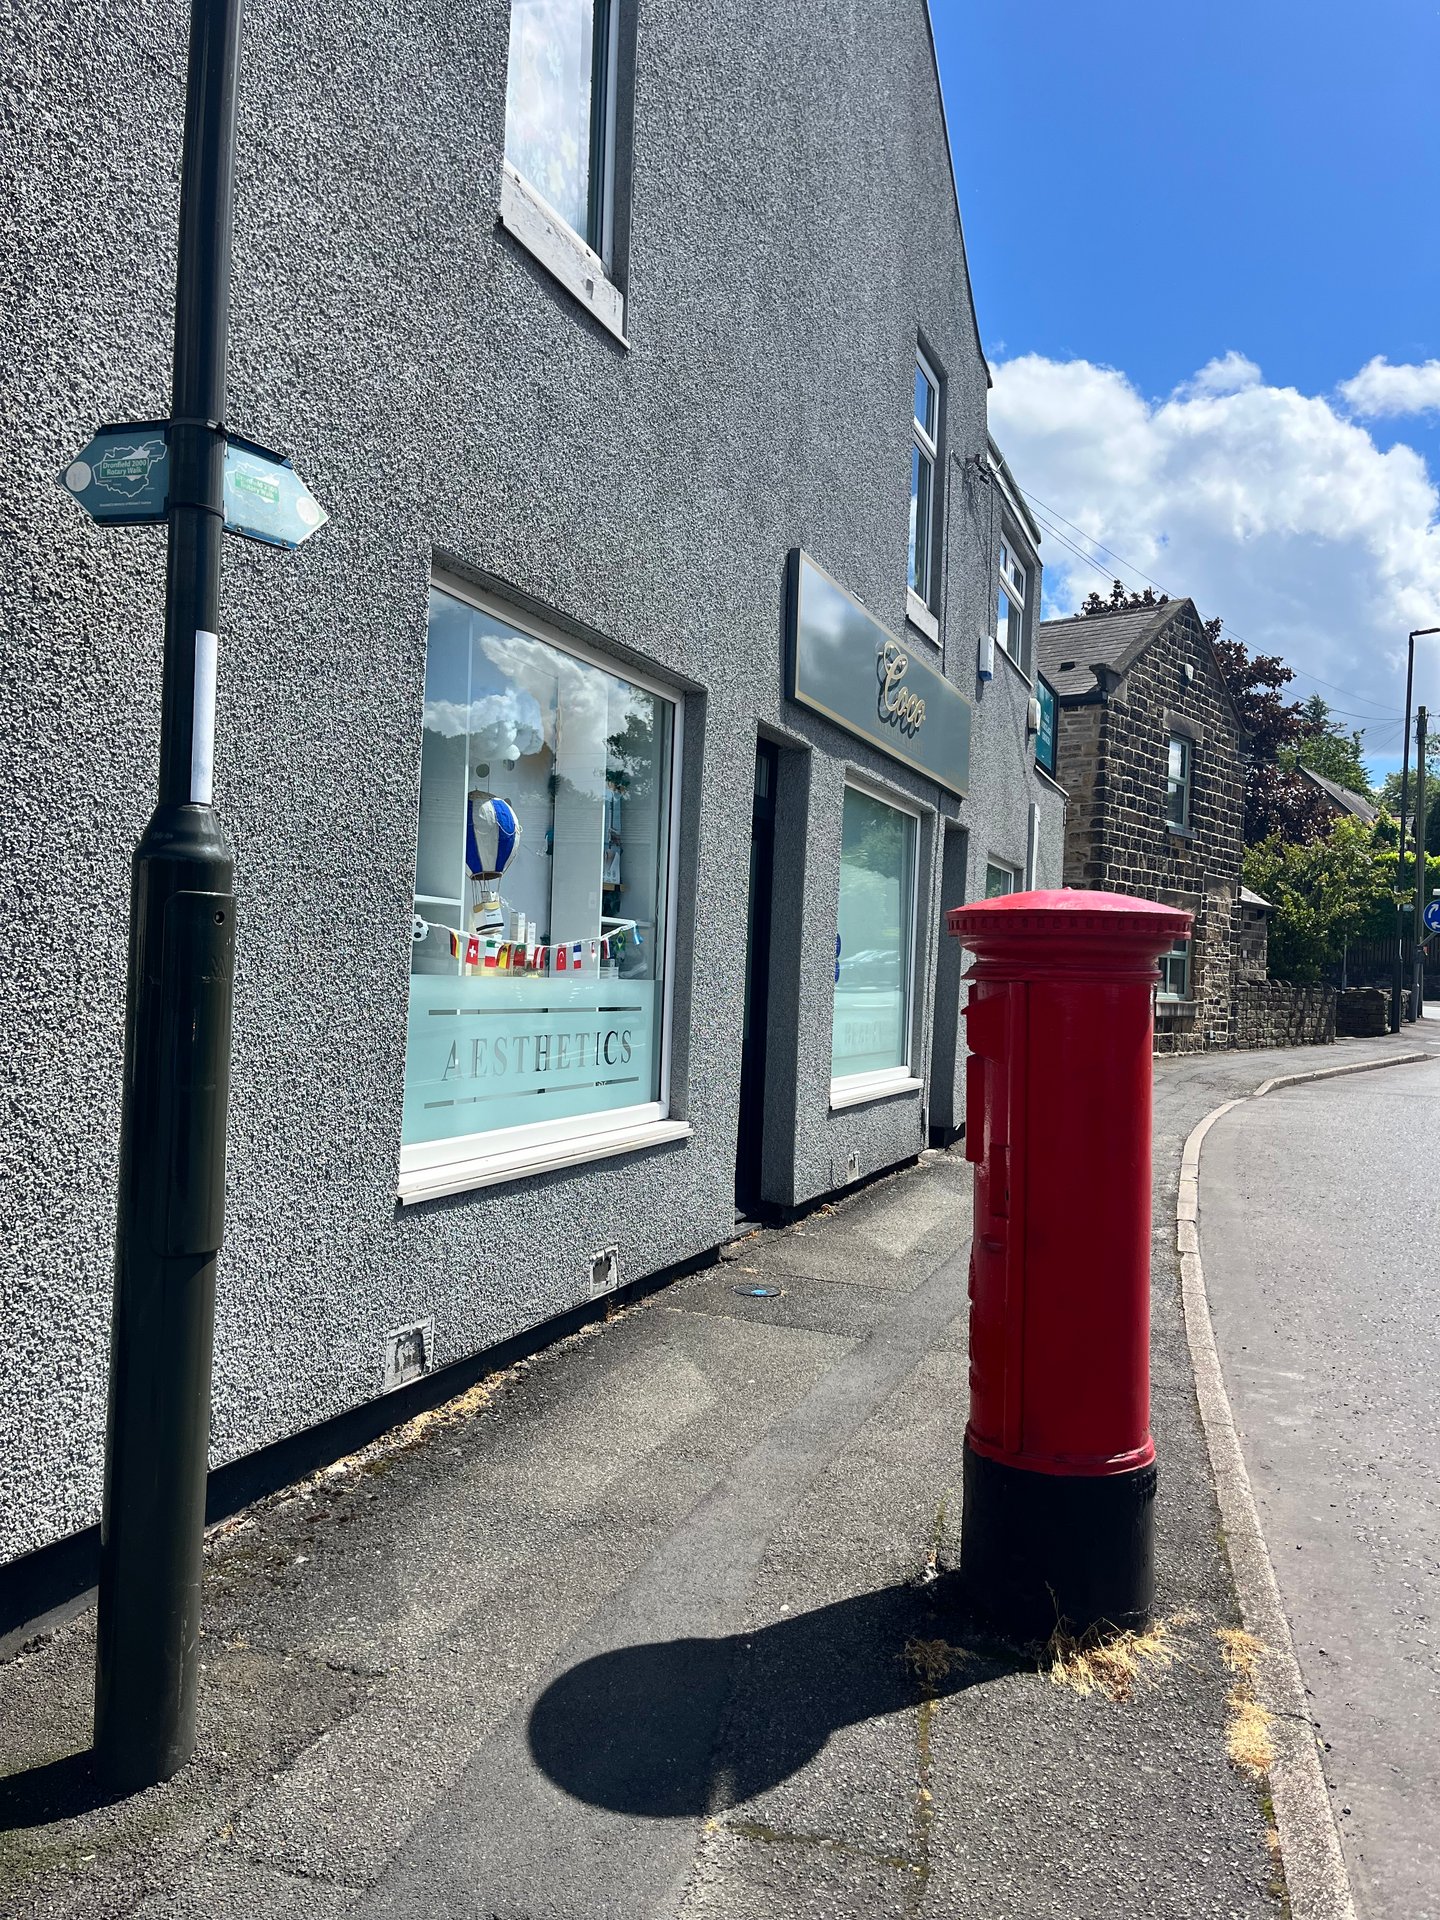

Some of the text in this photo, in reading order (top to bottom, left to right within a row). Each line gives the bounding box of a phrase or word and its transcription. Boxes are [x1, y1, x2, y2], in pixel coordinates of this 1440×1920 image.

[103, 459, 147, 469] Dronfield 2000
[106, 466, 142, 477] Rotary Walk
[884, 640, 926, 728] Coco
[441, 1030, 632, 1081] AESTHETICS
